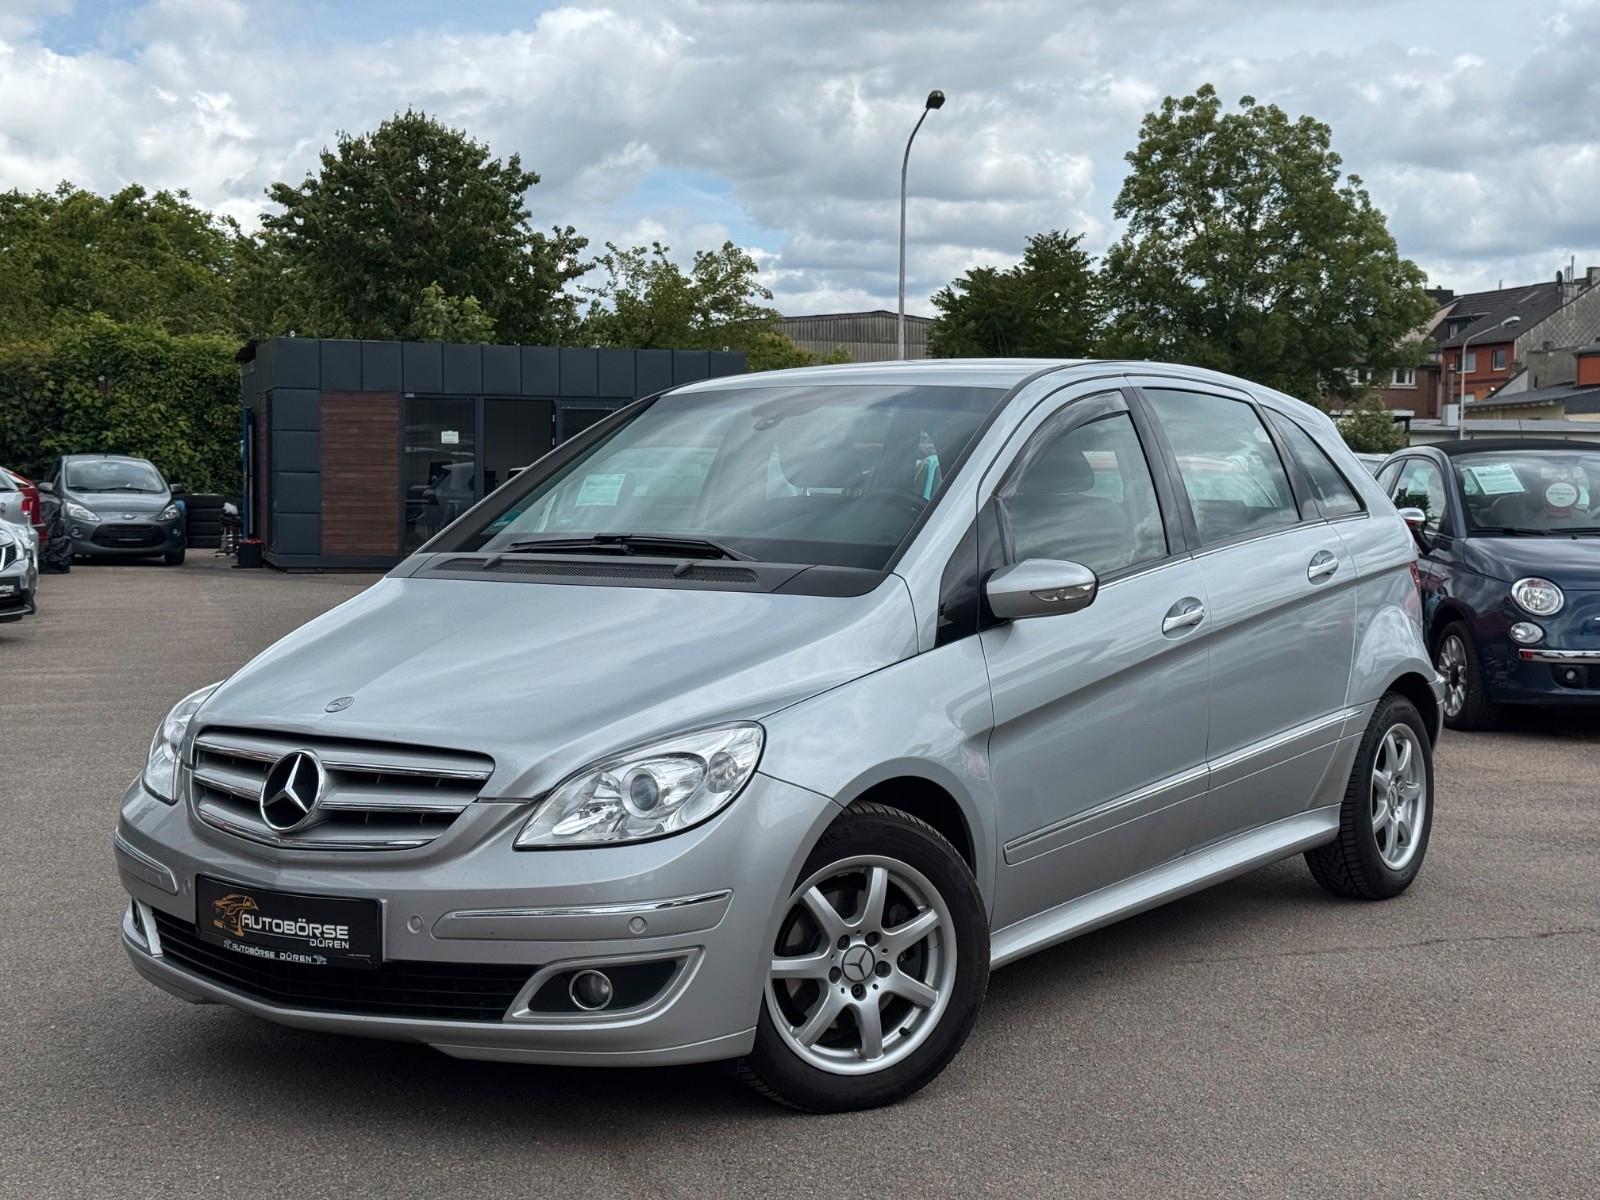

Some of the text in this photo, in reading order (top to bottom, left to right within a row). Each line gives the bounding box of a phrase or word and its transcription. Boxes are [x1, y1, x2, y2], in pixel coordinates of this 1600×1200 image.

[241, 913, 349, 939] AUTOBÖRSE
[232, 943, 312, 963] AUTOBÖRSE DÜREN
[309, 937, 350, 949] DÜREN
